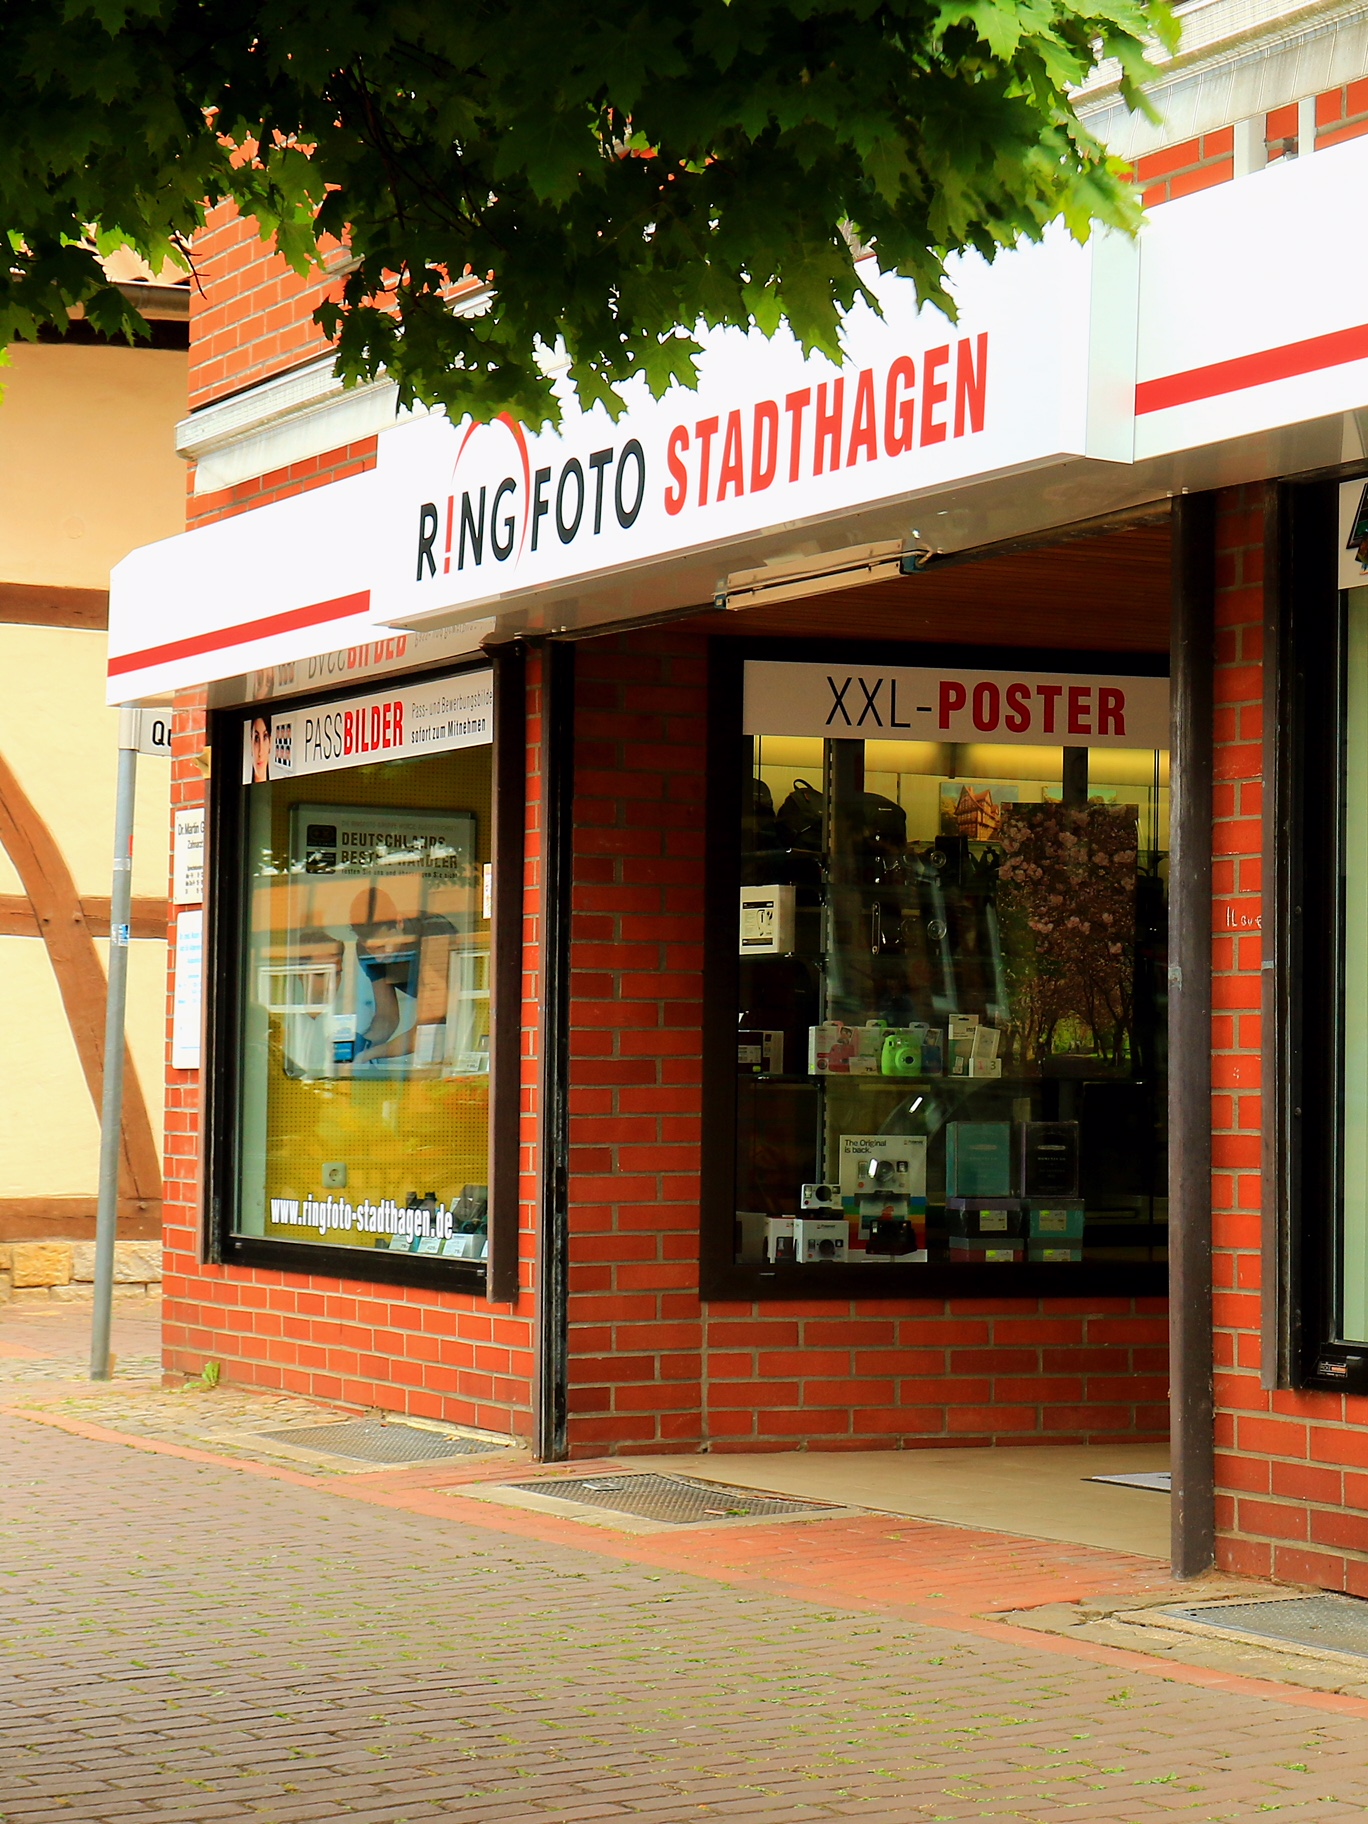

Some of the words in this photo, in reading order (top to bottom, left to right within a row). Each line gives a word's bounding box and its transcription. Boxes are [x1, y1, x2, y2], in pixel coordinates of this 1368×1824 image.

[664, 332, 989, 517] STADTHAGEN
[304, 701, 404, 762] PASSBILDER
[411, 702, 429, 719] Pass-
[430, 699, 441, 716] und
[411, 725, 431, 744] sofort
[432, 724, 446, 740] zum
[447, 717, 486, 737] Mitnehmen
[825, 676, 1126, 736] XXL-POSTER
[859, 1139, 887, 1148] Original
[270, 1192, 453, 1244] www.ringfoto-stadthagen.de
